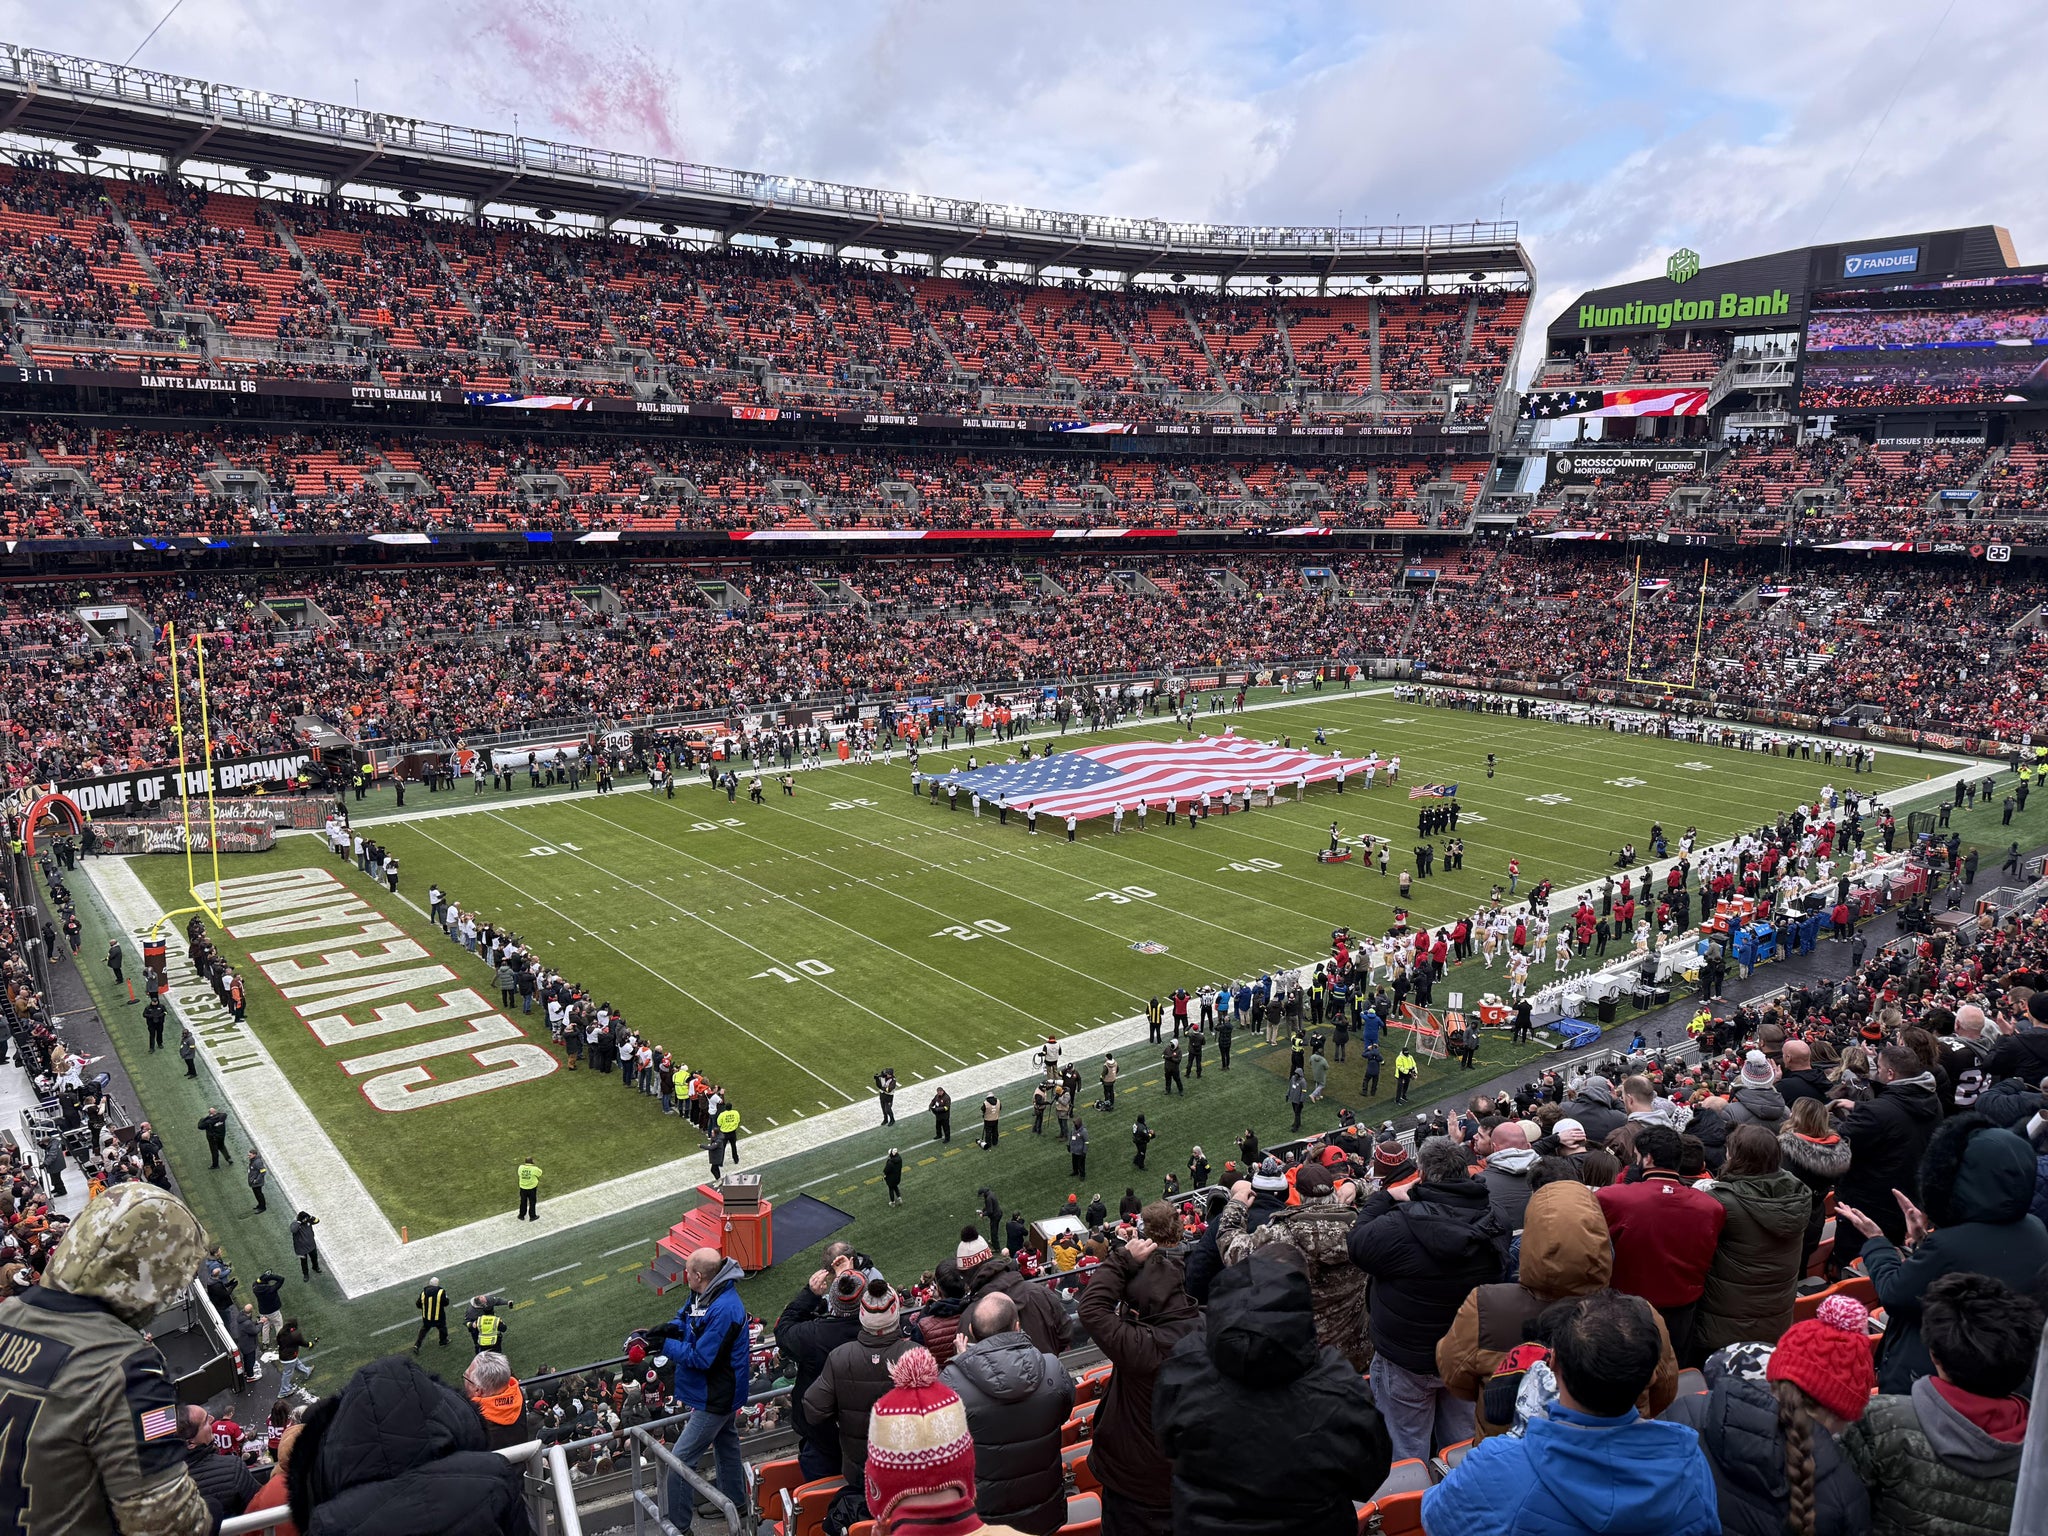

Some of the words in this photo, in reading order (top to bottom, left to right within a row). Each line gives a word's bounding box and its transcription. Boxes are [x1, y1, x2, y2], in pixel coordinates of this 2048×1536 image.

[1863, 254, 1915, 269] FANDUEL
[1578, 298, 1714, 329] Huntington
[1718, 288, 1790, 318] Bank
[20, 369, 53, 382] 3:17
[141, 375, 184, 389] DANTE
[187, 378, 236, 391] LAVELLI
[240, 380, 256, 393] 86
[352, 386, 381, 399] OTTO
[384, 388, 427, 402] GRAHAM
[430, 390, 442, 402] 14
[636, 402, 658, 412] PAUL
[661, 403, 690, 414] BROWN
[864, 414, 879, 423] JIM
[880, 415, 905, 425] BROWN
[908, 416, 918, 426] 32
[963, 418, 981, 428] PAUL
[982, 419, 1015, 429] WARFIELD
[1017, 420, 1027, 430] 42
[1169, 426, 1189, 434] GROZA
[1192, 426, 1200, 434] 76
[1213, 426, 1231, 434] OZZIE
[1233, 427, 1265, 435] NEWSOME
[1268, 427, 1277, 435] 82
[1292, 427, 1305, 435] MAC
[1307, 427, 1333, 435] SPEEDIE
[1359, 427, 1372, 435] JOE
[1373, 427, 1401, 435] THOMAS
[1402, 427, 1412, 436] 73
[1574, 458, 1654, 468] CROSSCOUNTRY
[1658, 463, 1694, 471] LANDING
[1574, 467, 1616, 475] MORTGAGE
[1685, 536, 1707, 545] 3:17
[1990, 548, 2007, 559] 25
[1168, 681, 1182, 689] 1946
[606, 736, 631, 748] 1946
[136, 776, 166, 803] OF
[172, 770, 216, 797] THE
[823, 799, 880, 811] 30
[212, 806, 243, 819] DAWG
[684, 817, 746, 833] 20
[519, 842, 583, 857] 10
[1216, 858, 1283, 874] 40
[1084, 885, 1158, 905] 30
[928, 918, 1012, 941] 20
[1718, 921, 1726, 929] G
[748, 958, 836, 984] 10
[193, 868, 562, 1114] CLEVELAND
[178, 993, 246, 1049] TAKES
[1488, 1011, 1498, 1020] G
[216, 1053, 265, 1074] IT
[1026, 1260, 1037, 1269] 54
